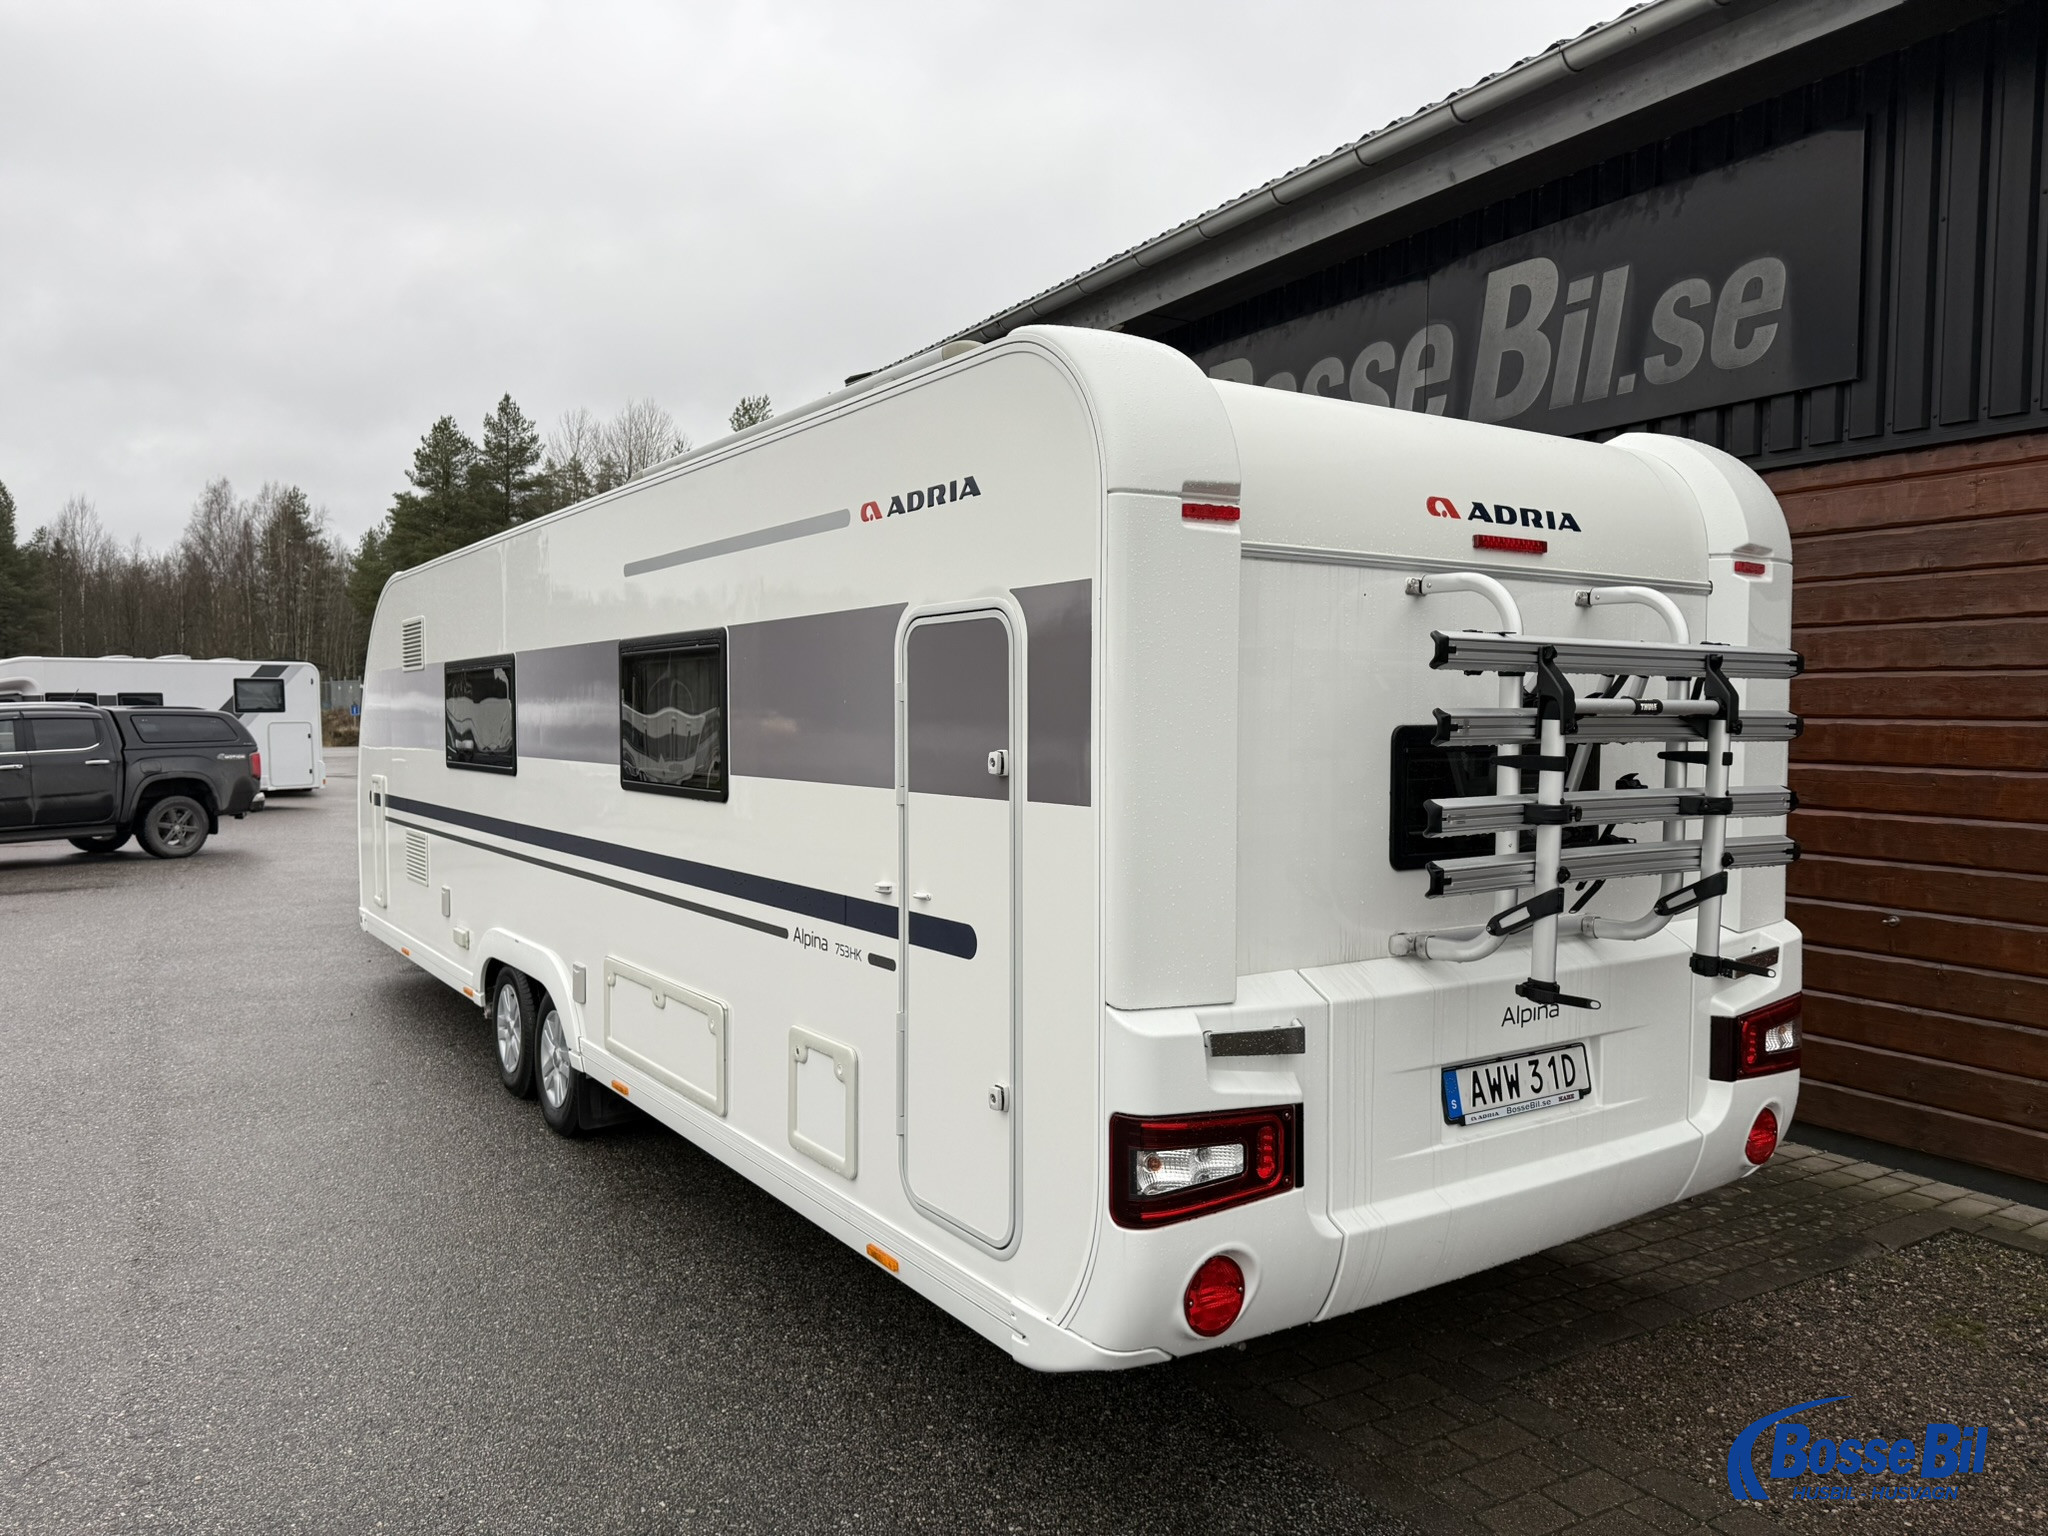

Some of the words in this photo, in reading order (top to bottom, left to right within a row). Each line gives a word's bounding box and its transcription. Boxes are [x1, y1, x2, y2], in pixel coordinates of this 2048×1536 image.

[887, 475, 982, 518] ADRIA
[1467, 501, 1582, 533] ADRIA
[793, 927, 829, 952] Alpina
[834, 942, 862, 962] 753HK
[1501, 1003, 1560, 1029] Alpina
[1472, 1062, 1521, 1108] AWW
[1528, 1053, 1576, 1094] 31D
[1451, 1100, 1457, 1109] S
[1506, 1099, 1552, 1115] BosseBil.se
